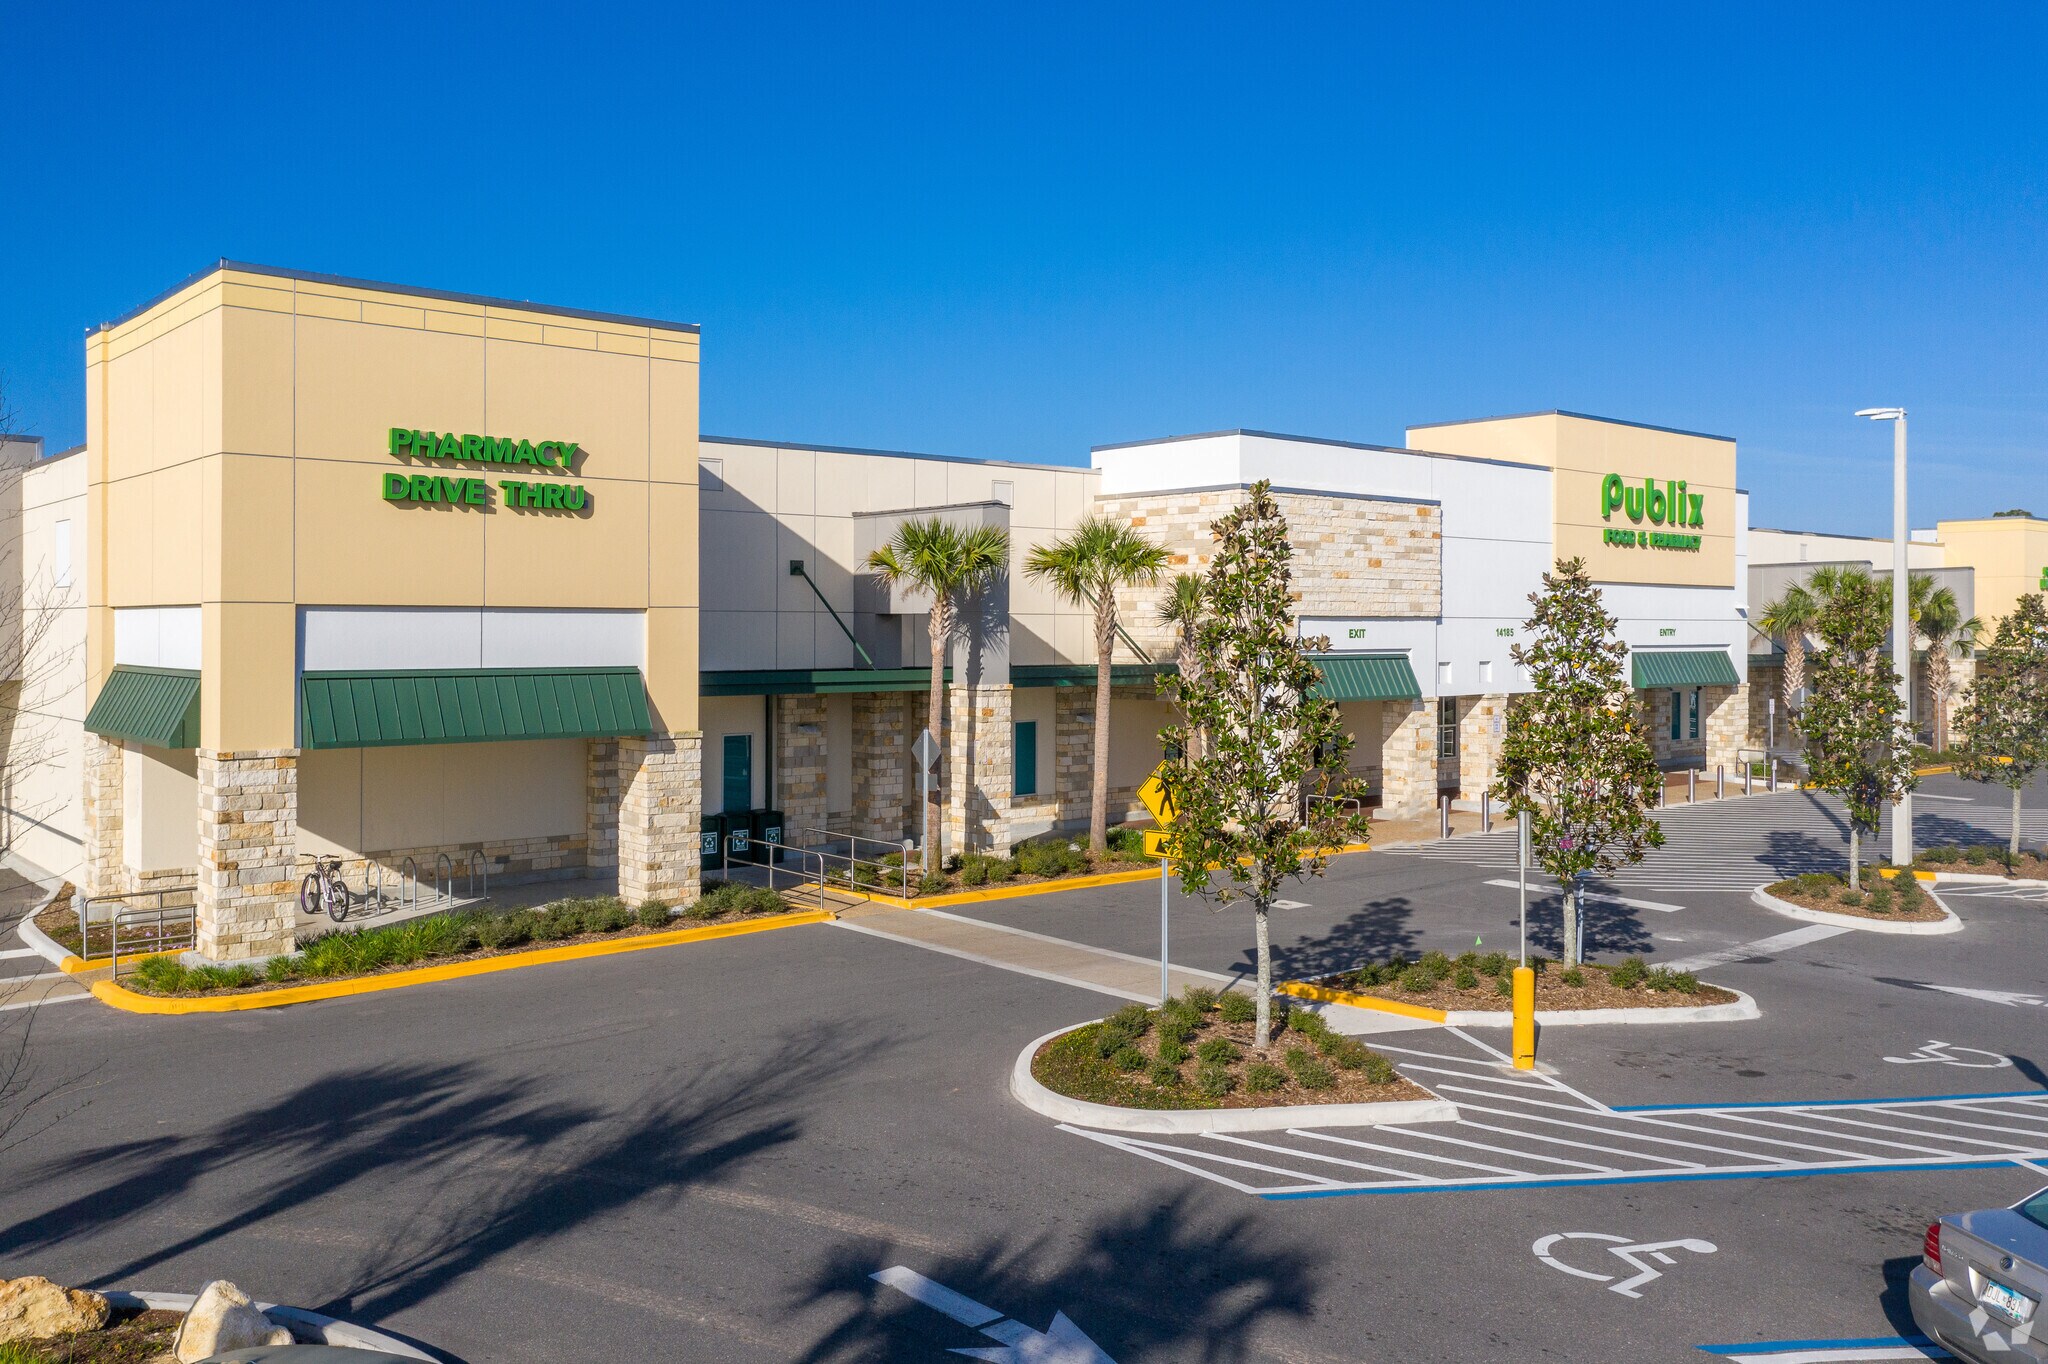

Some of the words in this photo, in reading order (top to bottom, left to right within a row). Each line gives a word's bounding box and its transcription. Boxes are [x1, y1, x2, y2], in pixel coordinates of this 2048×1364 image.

[389, 428, 579, 467] PHARMACY
[382, 473, 485, 505] DRIVE
[499, 480, 585, 510] THRU
[1602, 473, 1704, 525] Publix
[1348, 628, 1366, 639] EXIT
[1659, 628, 1676, 637] ENTRY
